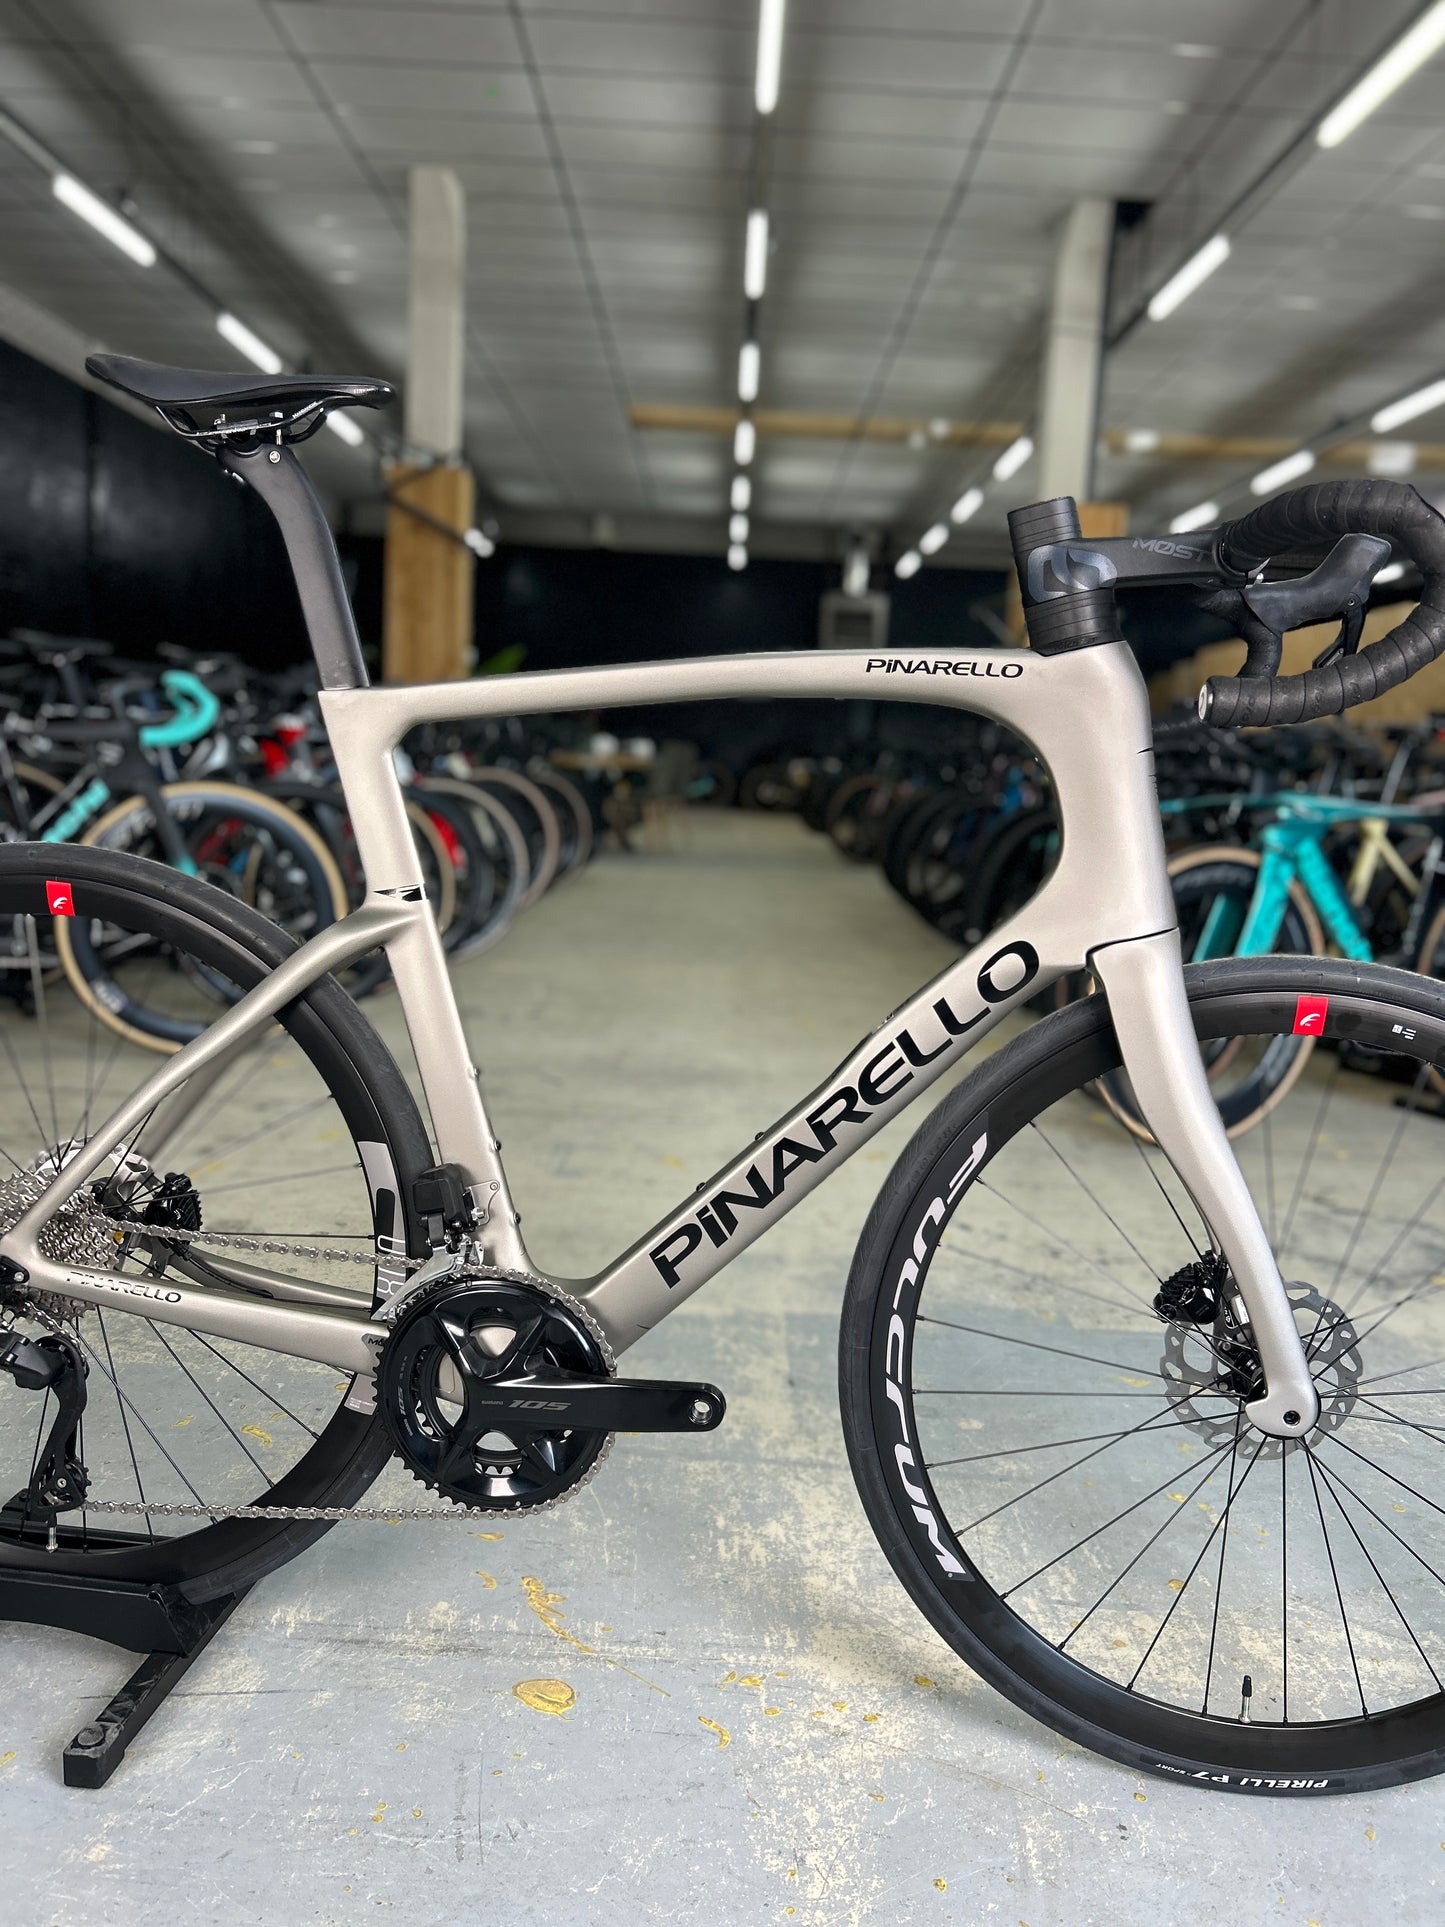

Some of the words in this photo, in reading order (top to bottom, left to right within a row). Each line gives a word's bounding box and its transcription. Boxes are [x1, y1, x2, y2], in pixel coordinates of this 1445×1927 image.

[508, 1399, 572, 1411] 105
[1191, 1771, 1230, 1784] P7
[1239, 1777, 1329, 1789] PIRELLI
